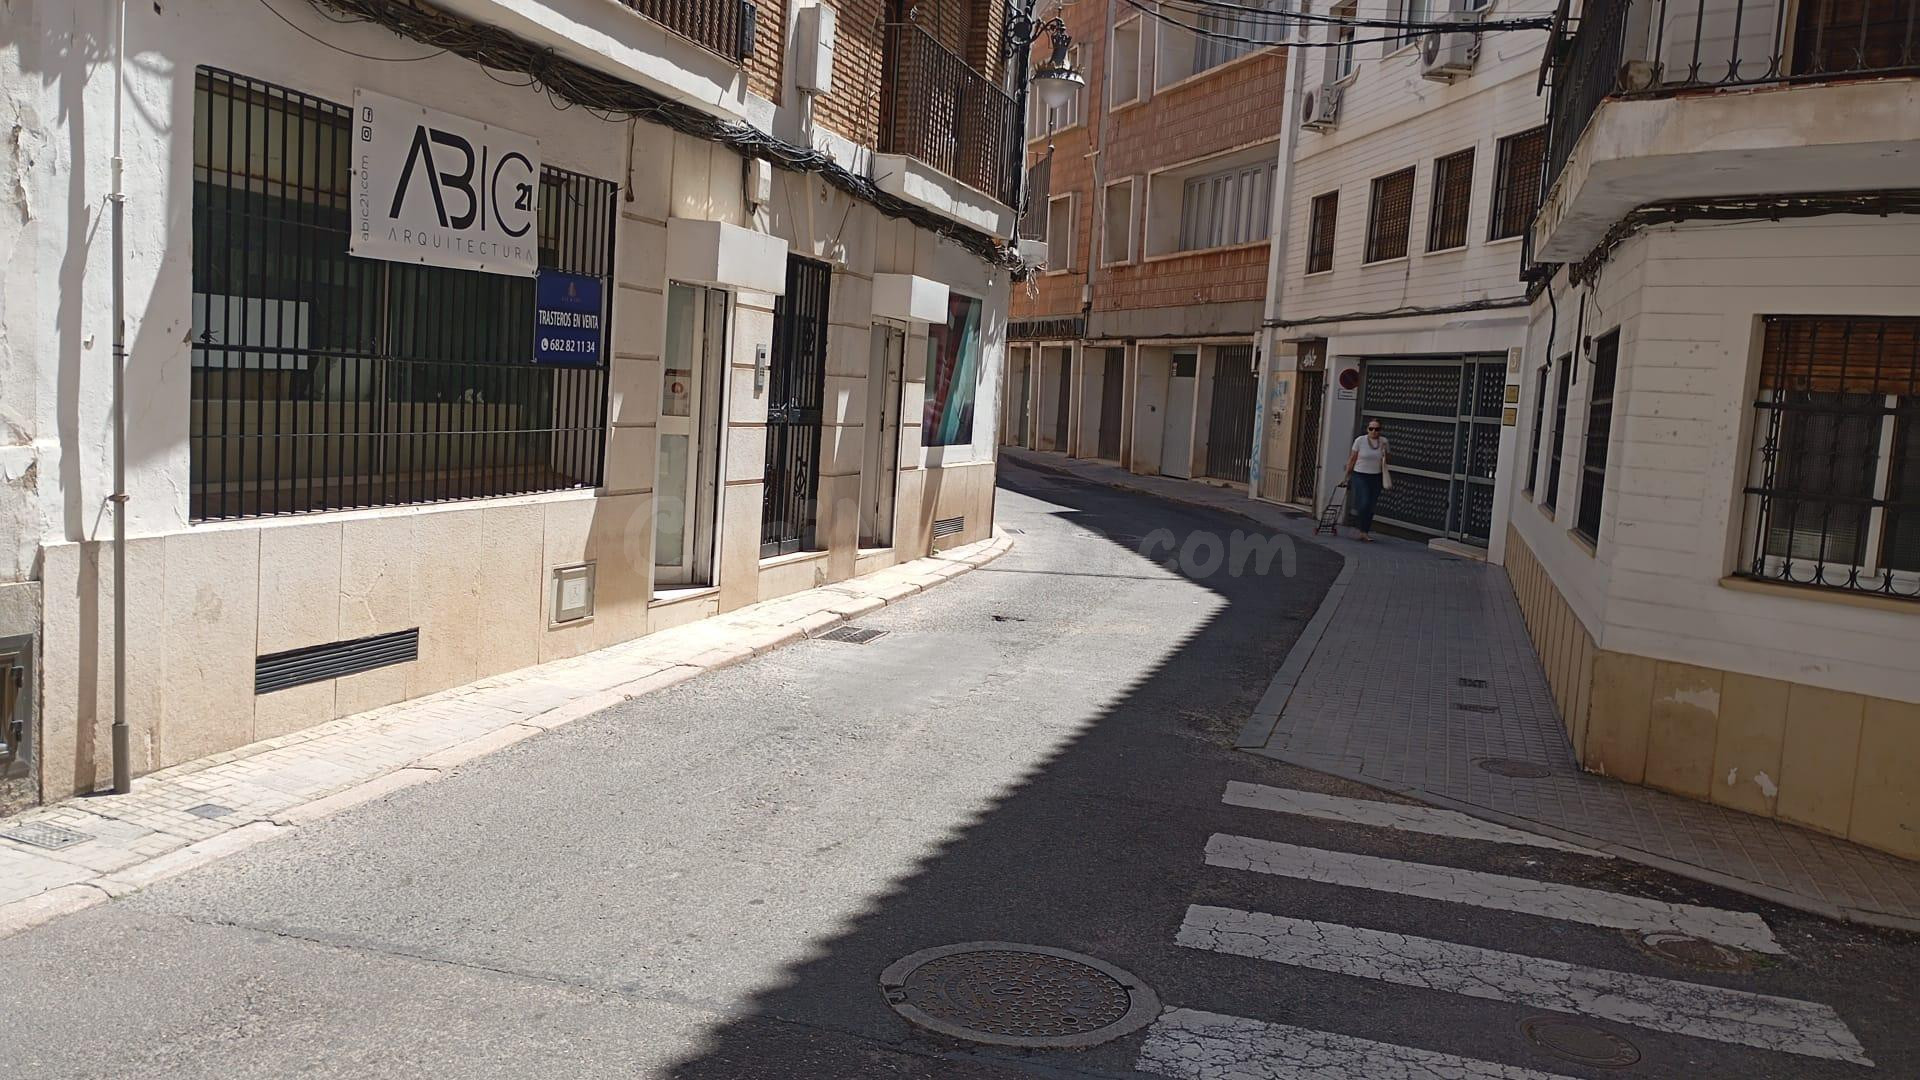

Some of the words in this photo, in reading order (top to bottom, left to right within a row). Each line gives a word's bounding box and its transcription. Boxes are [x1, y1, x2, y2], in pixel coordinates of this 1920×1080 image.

[389, 125, 534, 238] ABIC
[514, 182, 533, 212] 21
[360, 154, 369, 241] abic21.com
[388, 227, 533, 260] ARQUITECTURA
[539, 309, 571, 328] TRASTEROS
[573, 313, 581, 328] EN
[582, 313, 599, 330] VENTA
[550, 338, 565, 351] 682
[566, 339, 575, 352] 82
[577, 340, 585, 353] 11
[586, 341, 595, 353] 34
